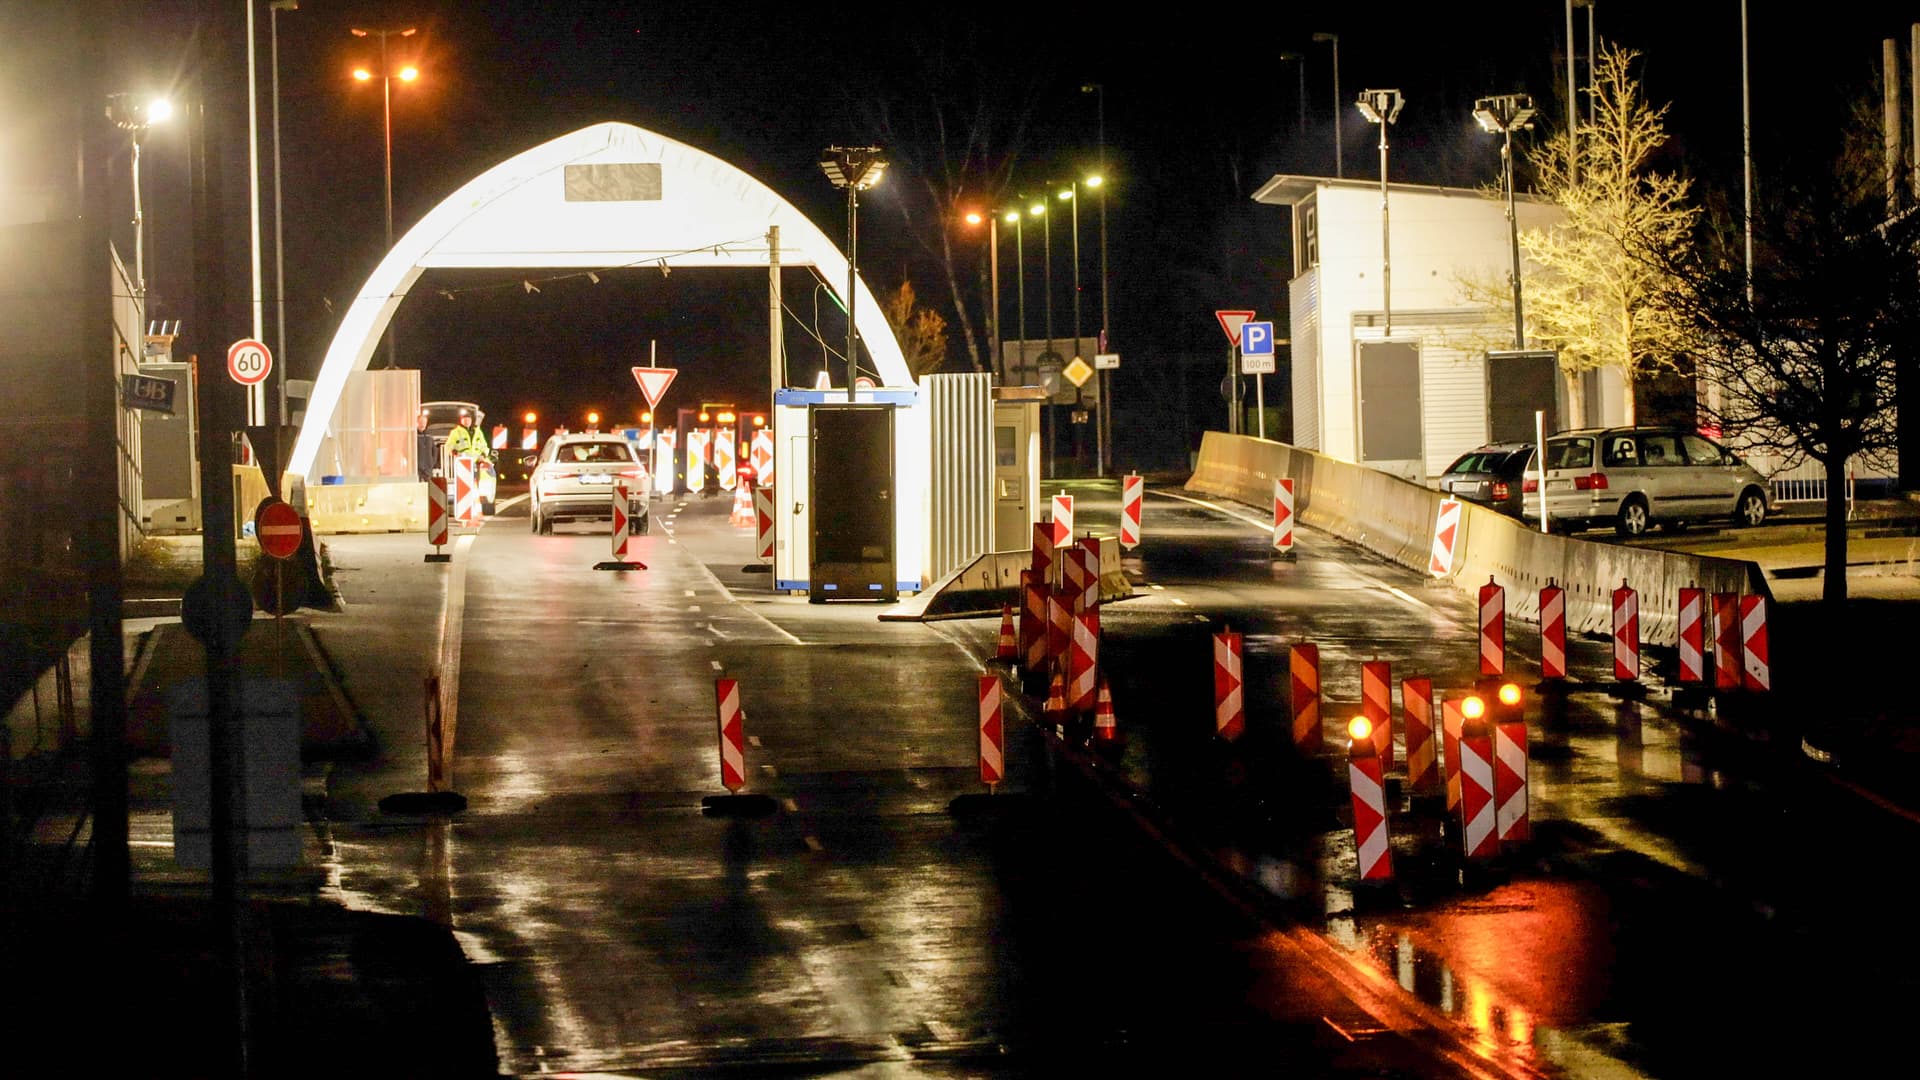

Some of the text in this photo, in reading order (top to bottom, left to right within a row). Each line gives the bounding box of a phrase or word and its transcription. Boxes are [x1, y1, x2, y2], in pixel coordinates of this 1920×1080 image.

[1248, 327, 1265, 351] P
[238, 352, 261, 372] 60
[1246, 360, 1260, 368] 100
